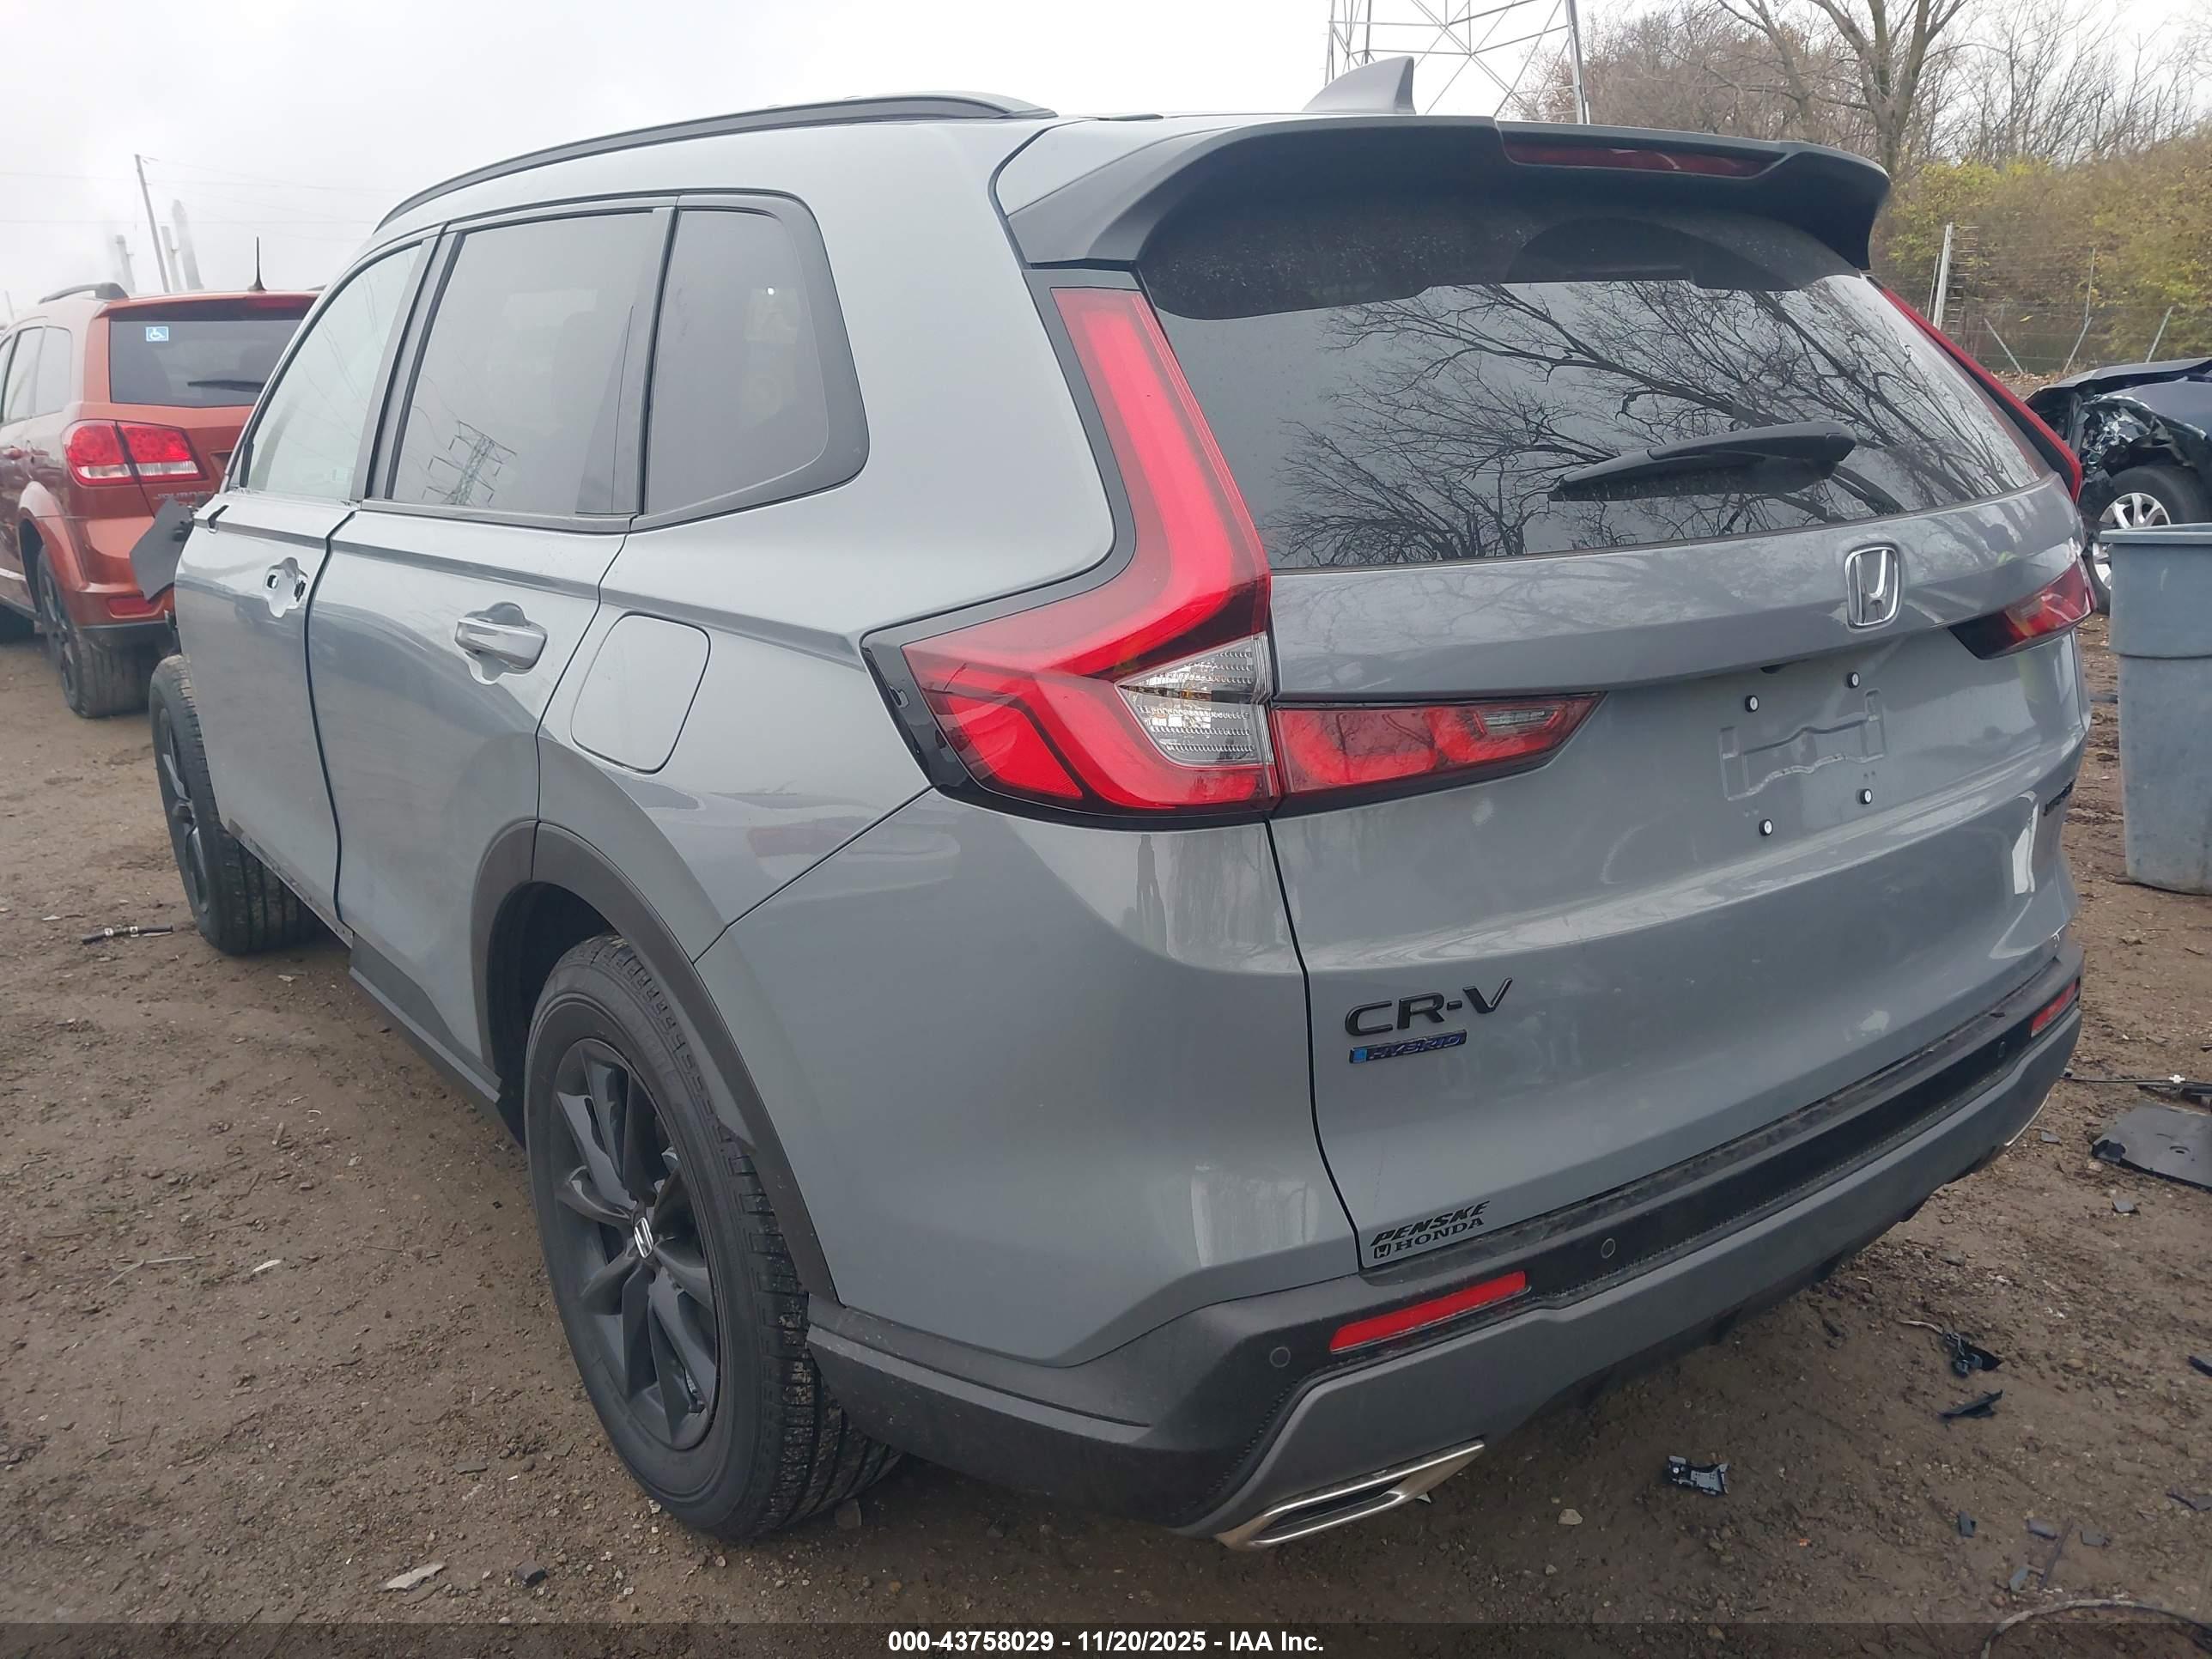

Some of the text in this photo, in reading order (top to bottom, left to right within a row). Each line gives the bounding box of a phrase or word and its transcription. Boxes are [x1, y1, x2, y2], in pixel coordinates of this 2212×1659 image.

[1826, 500, 1868, 516] AWD
[1345, 977, 1513, 1036] CR-V
[1370, 1200, 1491, 1247] PENSKE
[1394, 1218, 1485, 1252] HONDA
